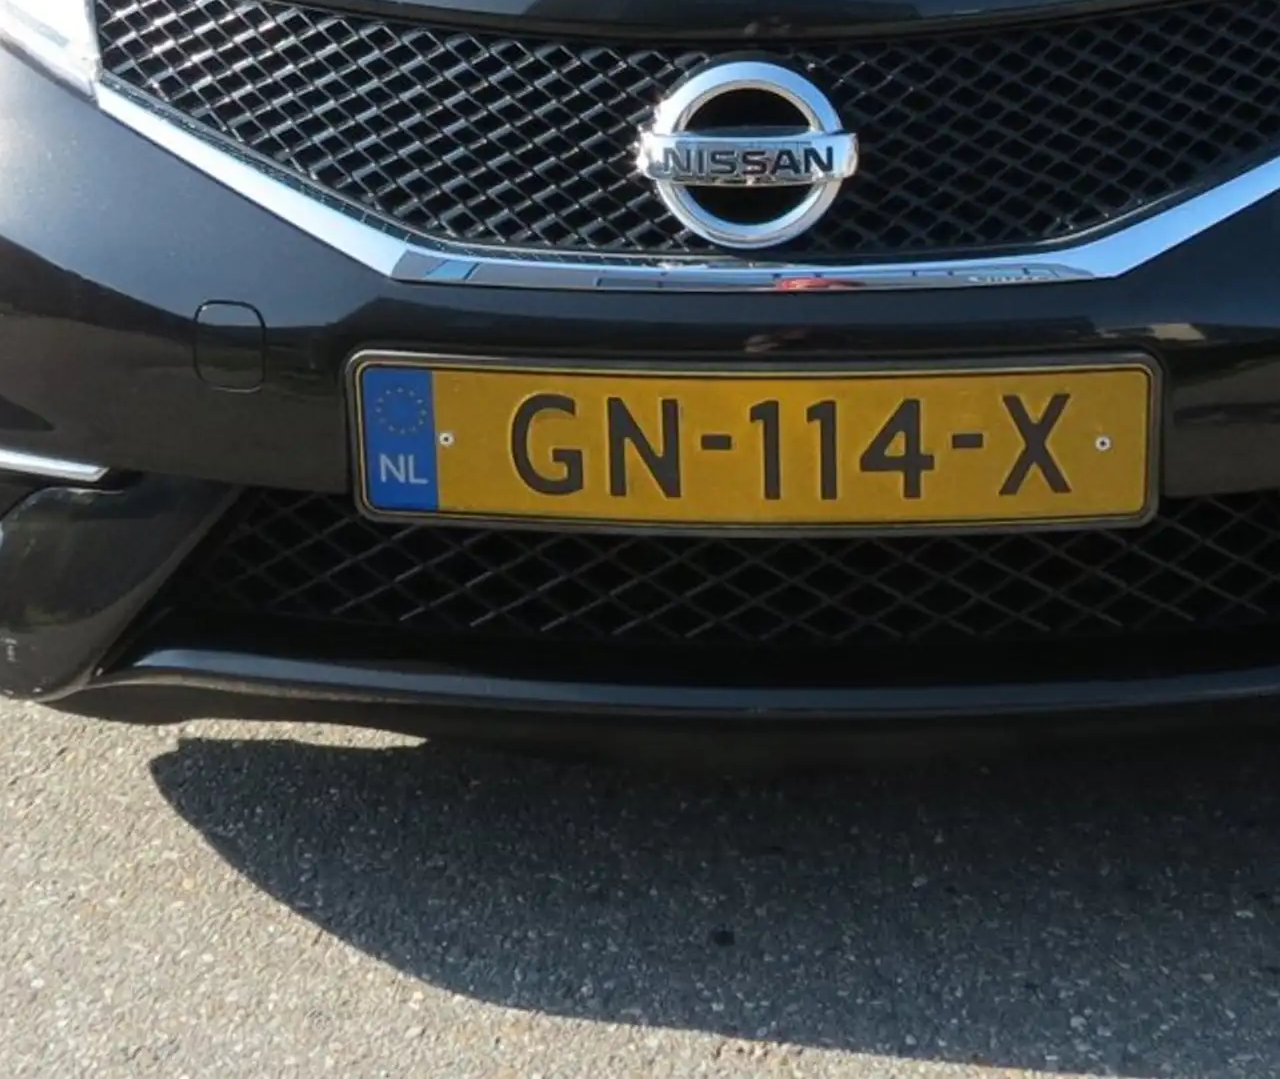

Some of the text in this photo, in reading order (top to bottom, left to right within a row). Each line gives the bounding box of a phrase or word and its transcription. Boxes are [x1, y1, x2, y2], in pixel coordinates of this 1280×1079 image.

[663, 147, 833, 175] NISSAN
[510, 393, 1072, 501] GN-114-X
[379, 453, 429, 484] NL
